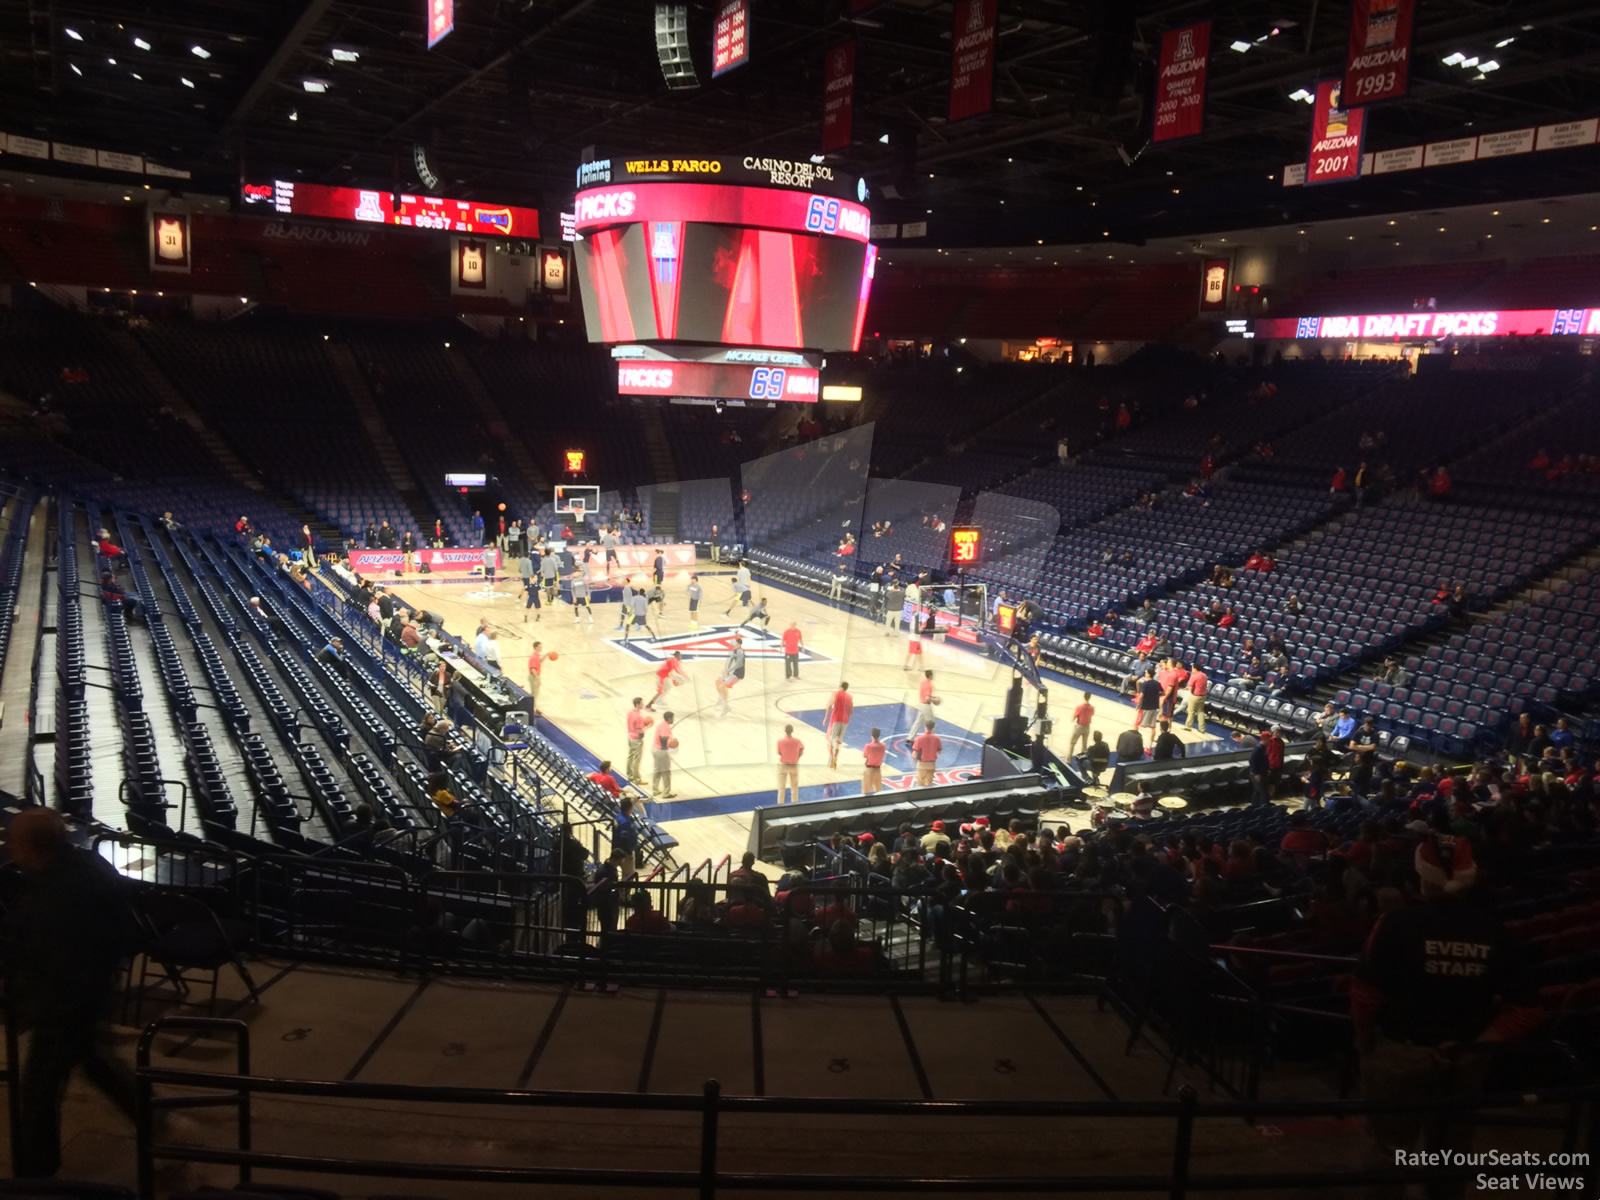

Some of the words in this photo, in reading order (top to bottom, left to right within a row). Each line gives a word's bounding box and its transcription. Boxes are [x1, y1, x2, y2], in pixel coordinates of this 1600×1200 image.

[956, 26, 994, 52] ARIZONA
[1161, 57, 1206, 78] ARIZONA
[1349, 47, 1408, 71] ARIZONA
[826, 74, 853, 93] ARIZONA
[1166, 77, 1196, 91] QUARTER
[1355, 71, 1396, 97] 1993
[1158, 99, 1178, 112] 2000
[1157, 112, 1176, 126] 2005
[1312, 135, 1359, 153] ARIZONA
[625, 160, 669, 173] WELLS
[672, 160, 722, 173] FARGO
[743, 156, 792, 173] CASINO
[794, 162, 815, 177] DEL
[816, 166, 834, 181] SOL
[1315, 155, 1349, 174] 2001
[770, 172, 815, 188] RESORT
[580, 191, 636, 221] PICKS
[415, 214, 451, 230] 59:57
[805, 195, 840, 235] 69
[839, 208, 867, 237] NBA
[165, 235, 176, 246] 31
[468, 260, 478, 271] 10
[549, 268, 560, 278] 22
[1209, 280, 1221, 291] 86
[1297, 317, 1320, 338] 69
[1321, 316, 1360, 338] NBA
[1363, 314, 1431, 336] DRAFT
[1432, 312, 1497, 334] PICKS
[1551, 309, 1585, 335] 69
[625, 368, 673, 389] PICKS
[749, 367, 786, 400] 69
[956, 542, 974, 560] 30
[1424, 940, 1491, 959] EVENT
[1424, 959, 1488, 976] STAFF
